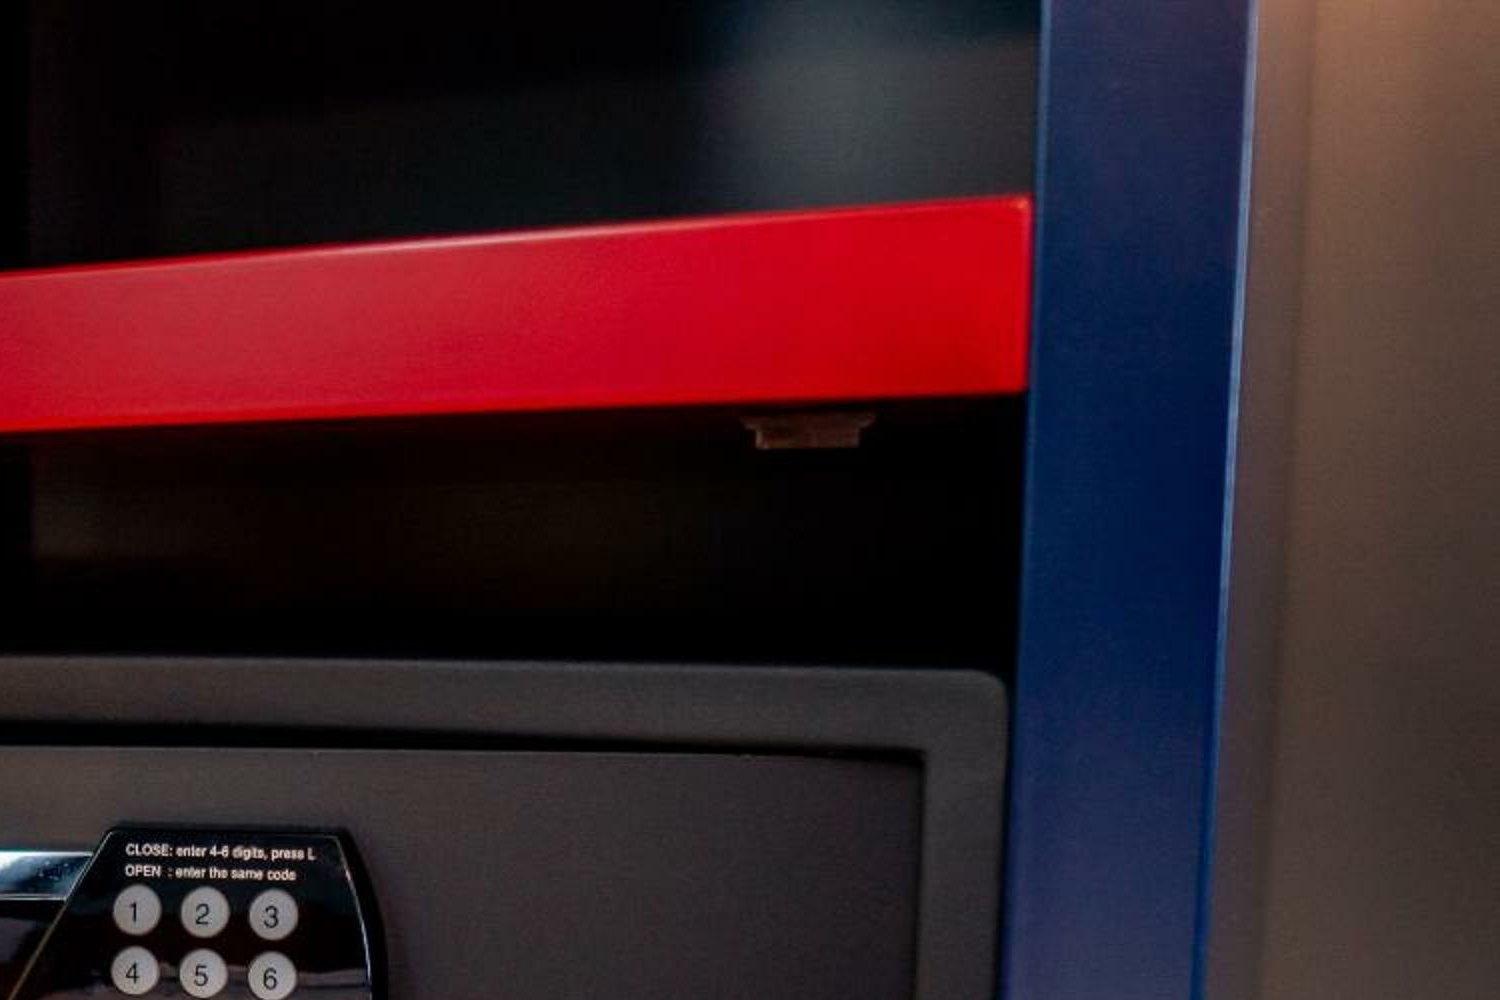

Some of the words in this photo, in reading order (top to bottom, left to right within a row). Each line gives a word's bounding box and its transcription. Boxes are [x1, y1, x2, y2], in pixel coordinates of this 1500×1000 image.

[125, 843, 173, 857] CLOSE:
[175, 845, 207, 857] enter
[232, 844, 268, 861] digits,
[271, 847, 305, 862] press
[307, 846, 317, 860] L
[125, 863, 162, 878] OPEN
[175, 865, 206, 878] enter
[209, 865, 228, 879] the
[231, 868, 263, 880] same
[267, 867, 297, 881] code
[129, 901, 137, 923] 1
[195, 903, 210, 925] 2
[263, 905, 279, 928] 3
[125, 962, 140, 984] 4
[194, 965, 209, 987] 5
[263, 967, 278, 990] 6
